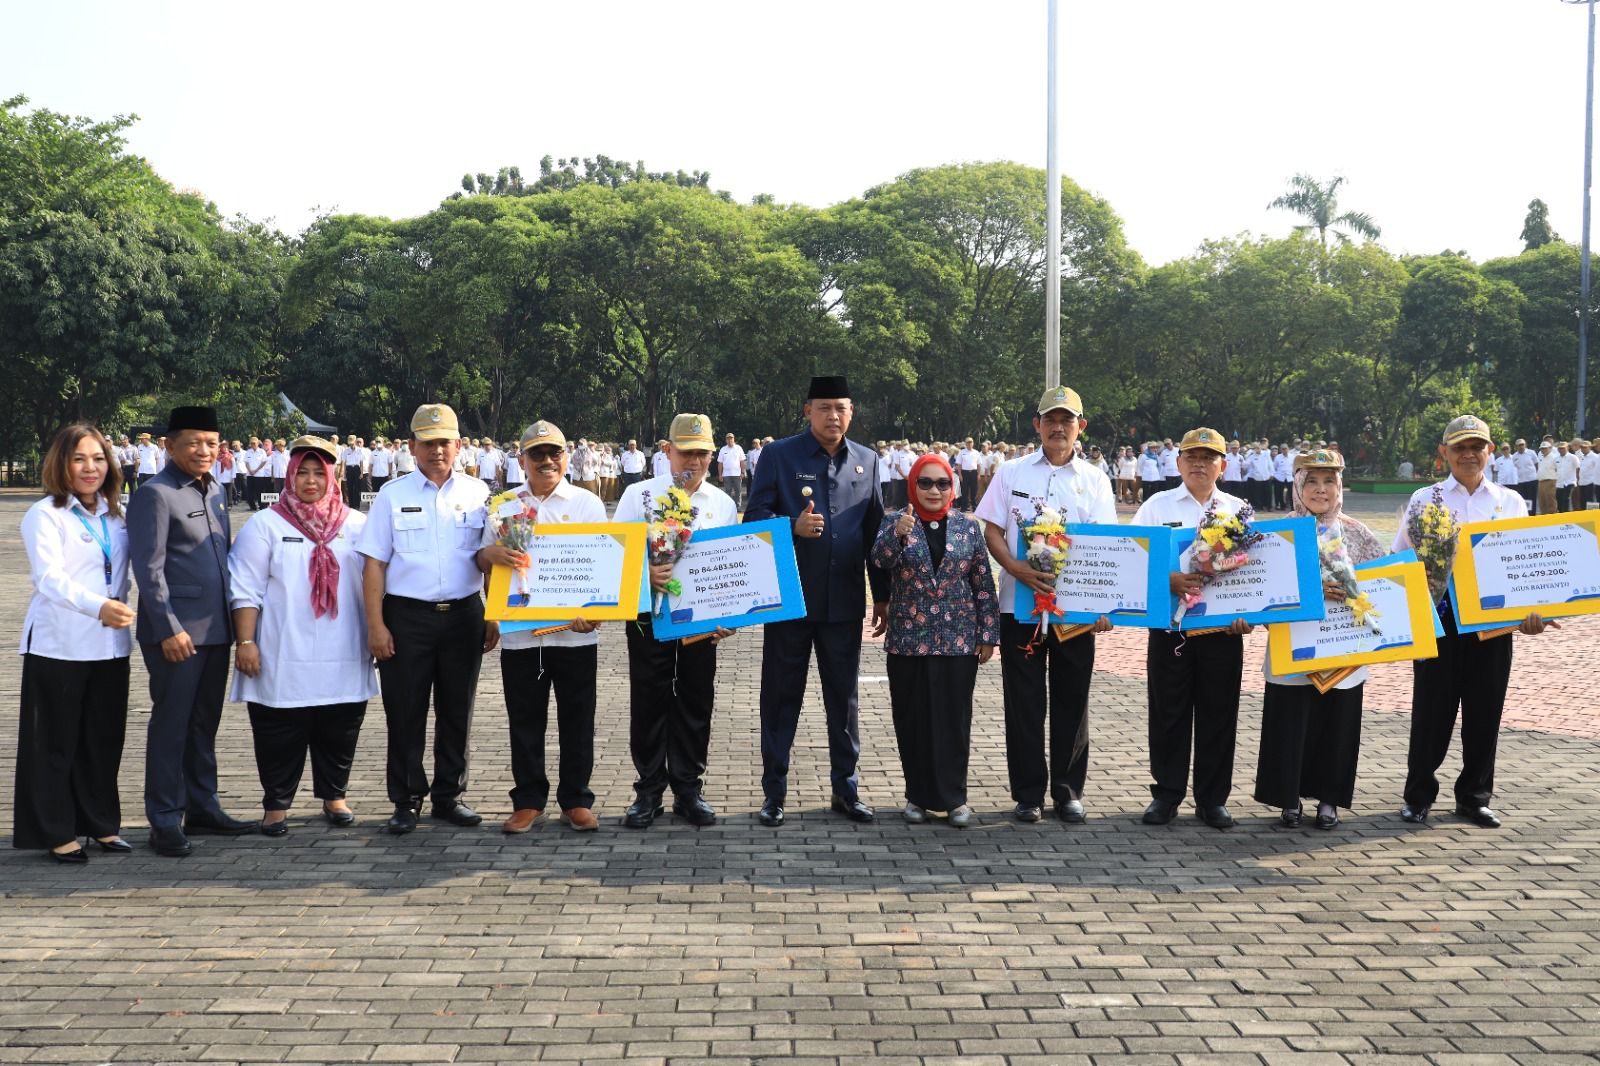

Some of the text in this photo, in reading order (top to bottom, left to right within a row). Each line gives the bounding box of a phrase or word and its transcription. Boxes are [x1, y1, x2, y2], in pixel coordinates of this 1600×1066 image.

[1515, 550, 1568, 561] 80.587.600,-
[1522, 569, 1569, 578] 4.479.200,-
[708, 580, 749, 590] 4.536.700,-
[1076, 578, 1118, 586] 4.262.800,-
[1225, 578, 1267, 586] 3.834.100,-
